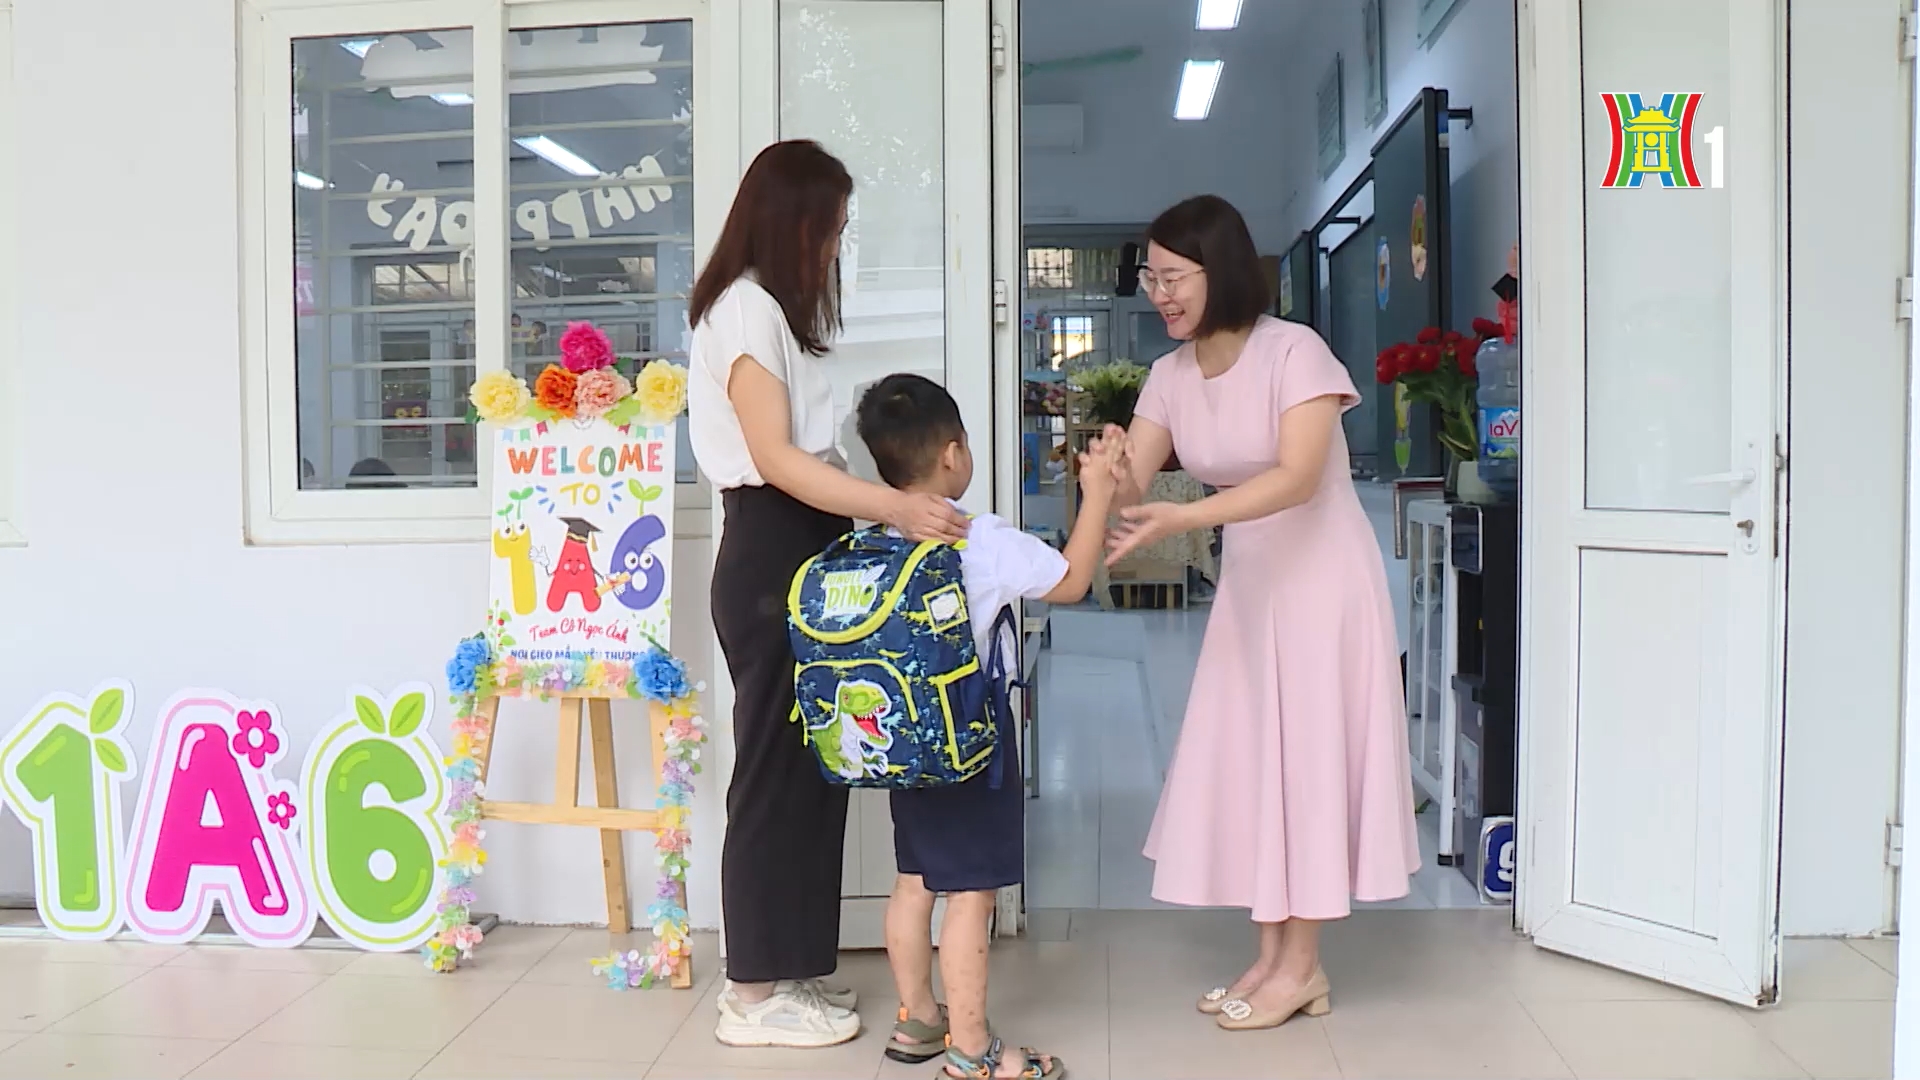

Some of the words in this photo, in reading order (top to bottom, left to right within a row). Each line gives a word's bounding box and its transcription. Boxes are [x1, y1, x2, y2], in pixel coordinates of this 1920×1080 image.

[1489, 419, 1519, 437] laV
[507, 443, 664, 477] WELCOME
[559, 482, 601, 506] TO
[493, 514, 666, 615] 1A6
[826, 584, 874, 610] DINO
[529, 624, 558, 641] Team
[606, 619, 629, 644] Ánh
[16, 723, 434, 923] 1A6
